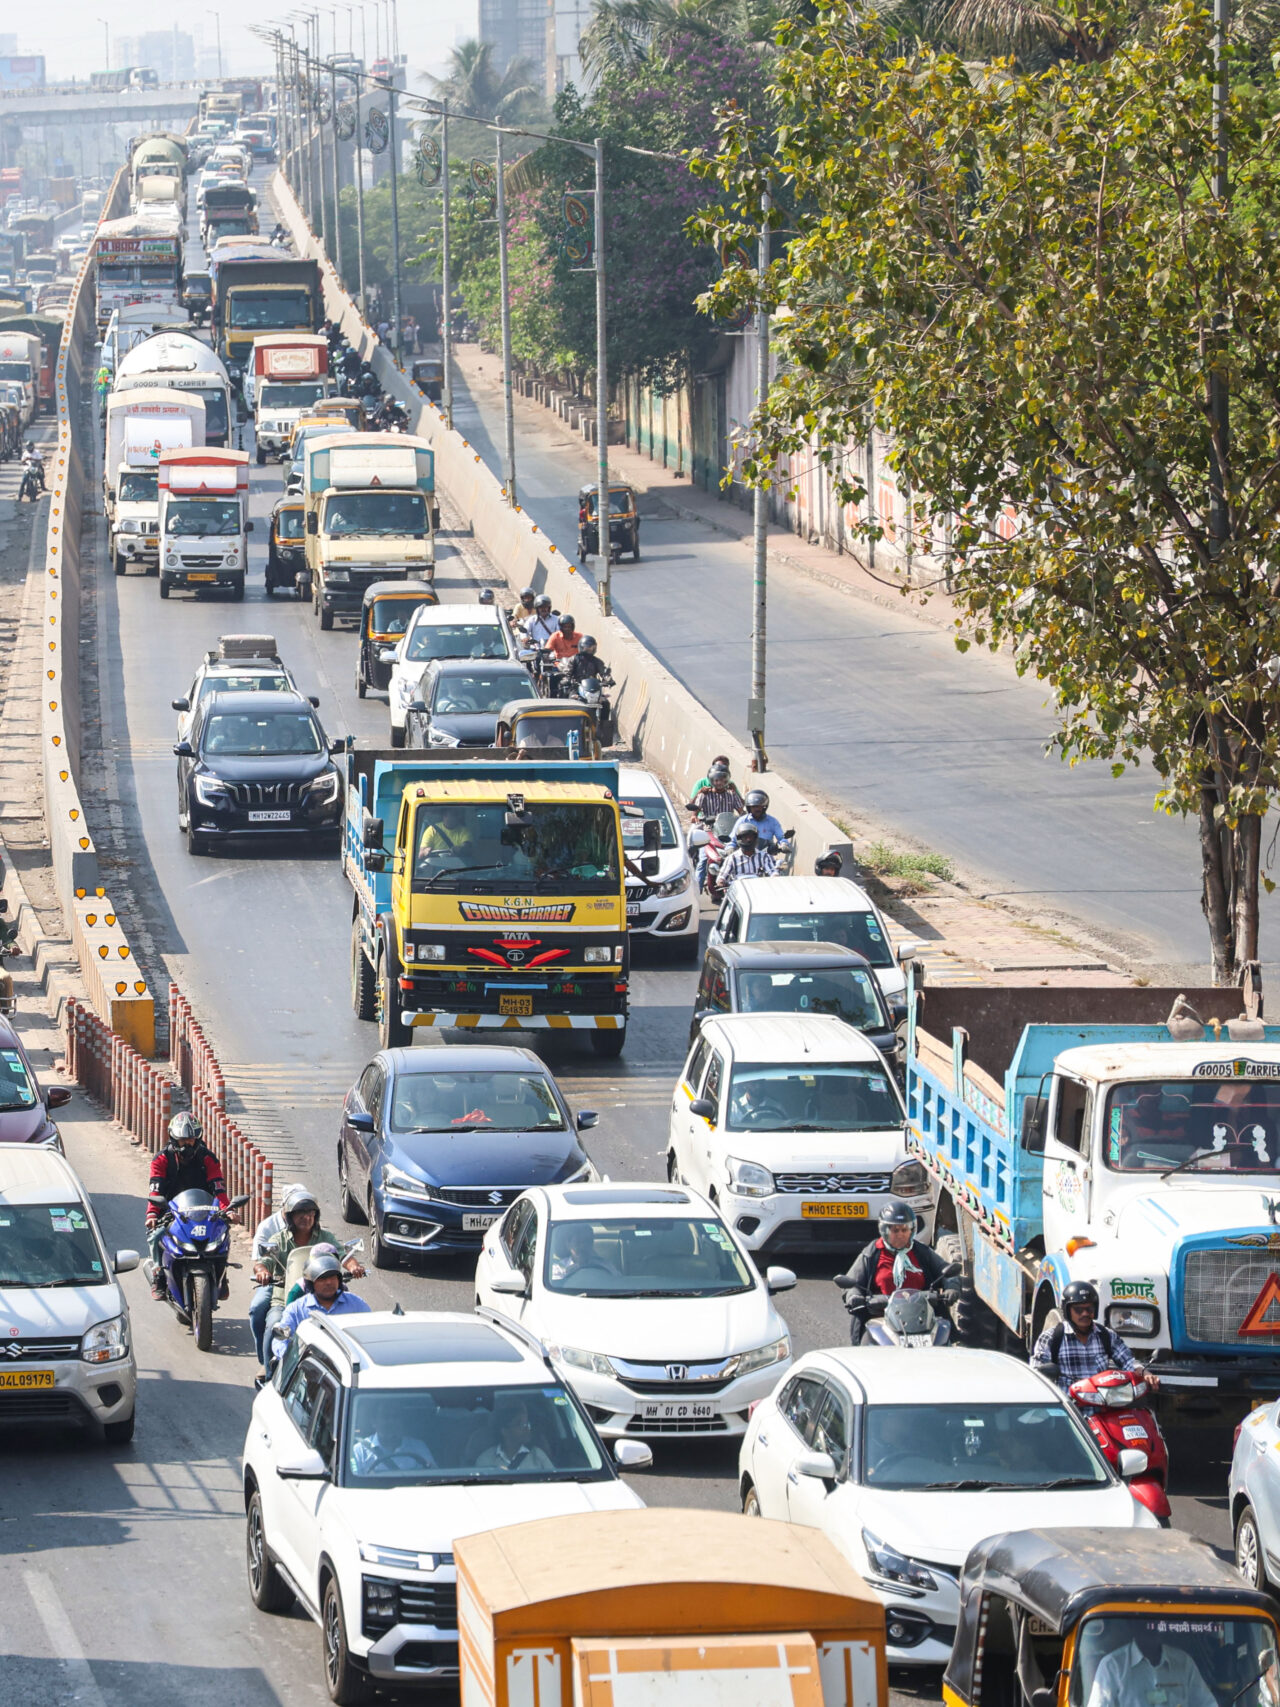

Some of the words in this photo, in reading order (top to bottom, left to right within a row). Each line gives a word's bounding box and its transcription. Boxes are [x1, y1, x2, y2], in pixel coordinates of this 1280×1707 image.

[503, 898, 535, 906] K.G.N.
[461, 902, 519, 920] GOODS
[520, 904, 572, 920] CARRIER
[502, 932, 531, 940] TATA
[1199, 1064, 1232, 1076] GOODS
[808, 1206, 865, 1215] MH01EE1590
[470, 1217, 498, 1227] MH47
[191, 1225, 207, 1236] 46
[646, 1406, 658, 1416] MH
[665, 1406, 673, 1416] 01
[677, 1406, 688, 1416] CD
